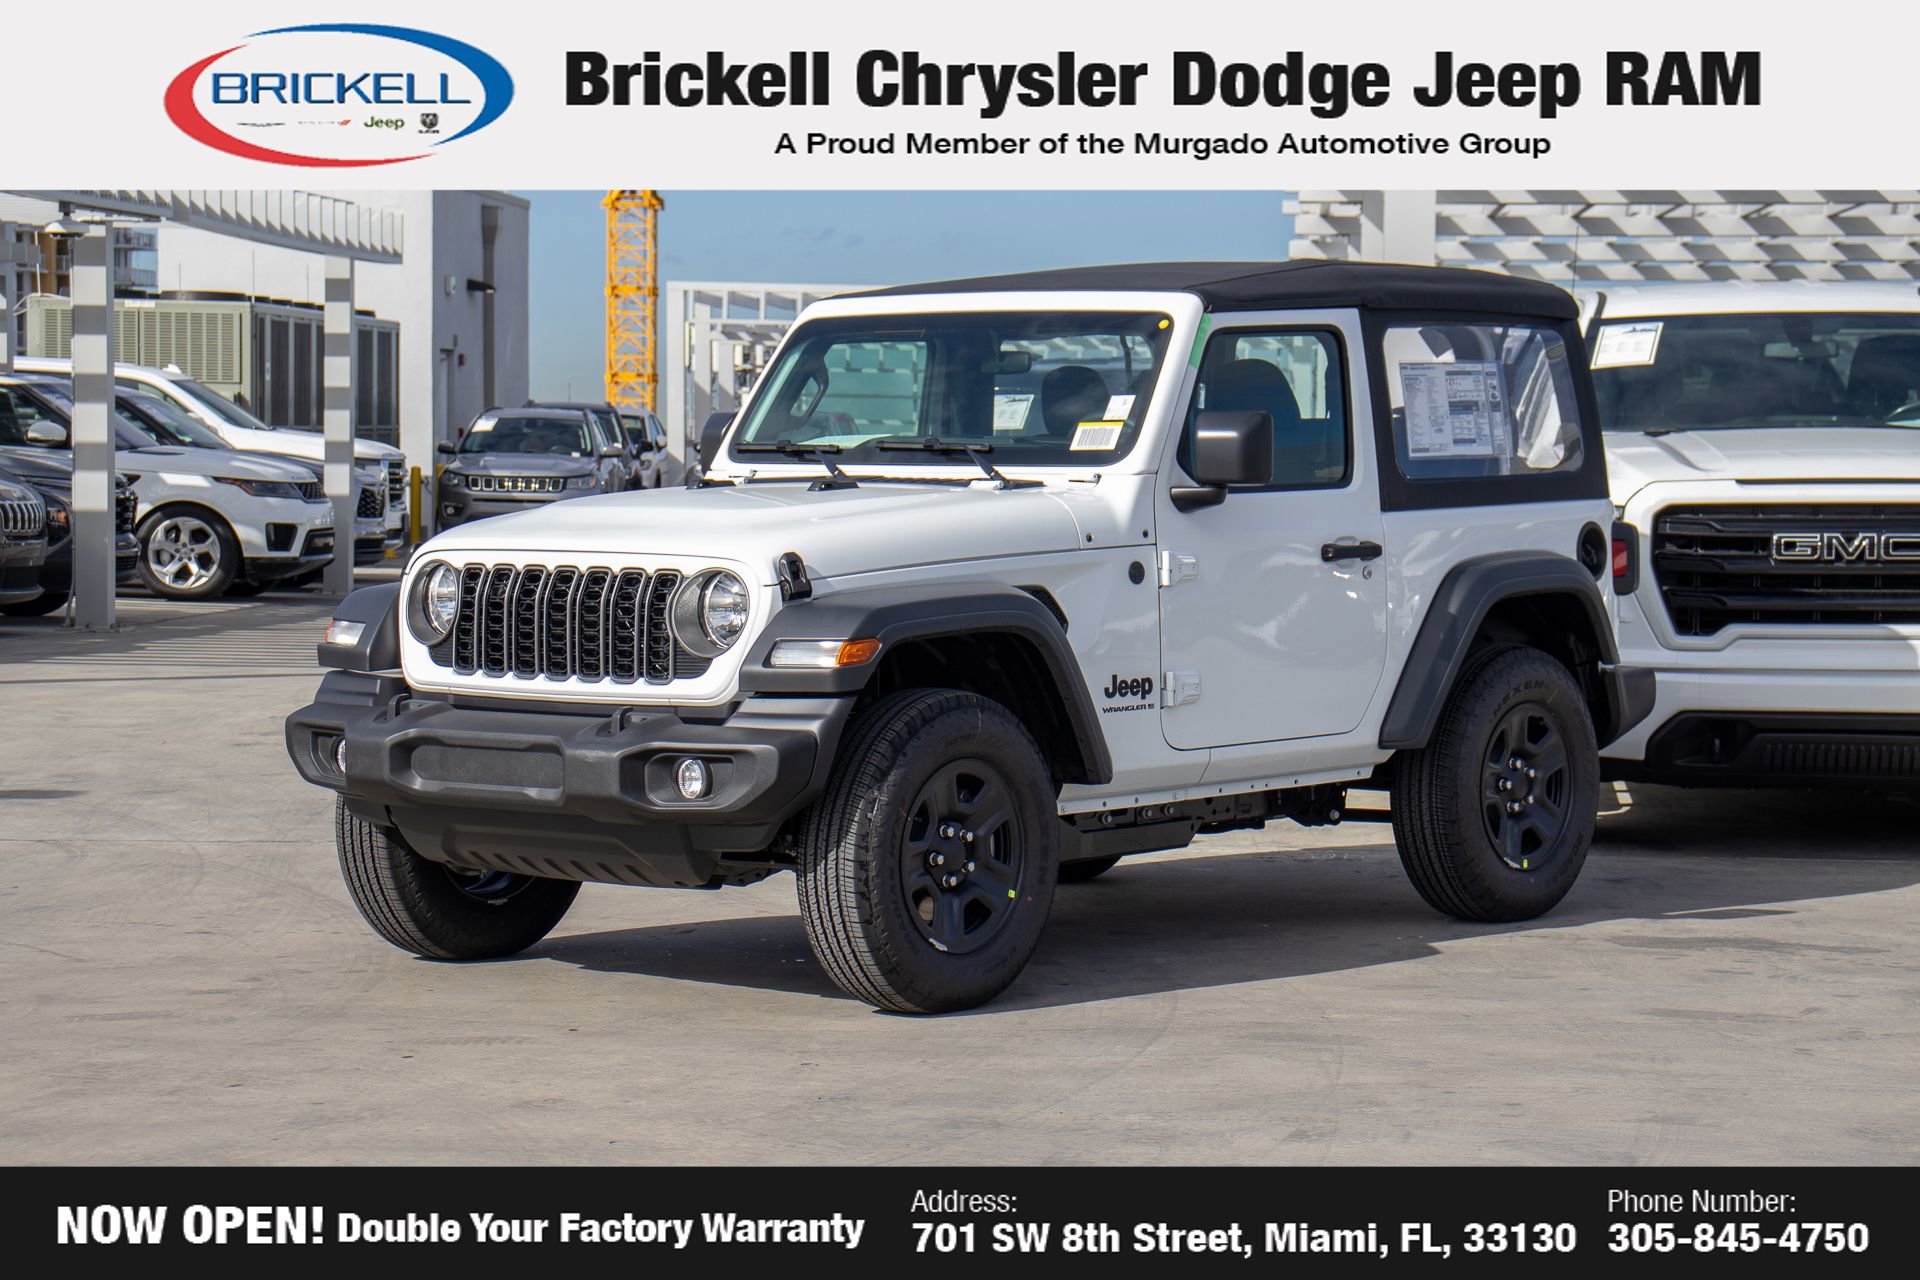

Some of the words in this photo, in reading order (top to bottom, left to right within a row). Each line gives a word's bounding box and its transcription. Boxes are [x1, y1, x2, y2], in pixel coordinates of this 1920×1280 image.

[1773, 533, 1920, 560] GMC
[1104, 674, 1154, 700] Jeep
[1102, 704, 1147, 714] WRANGLER
